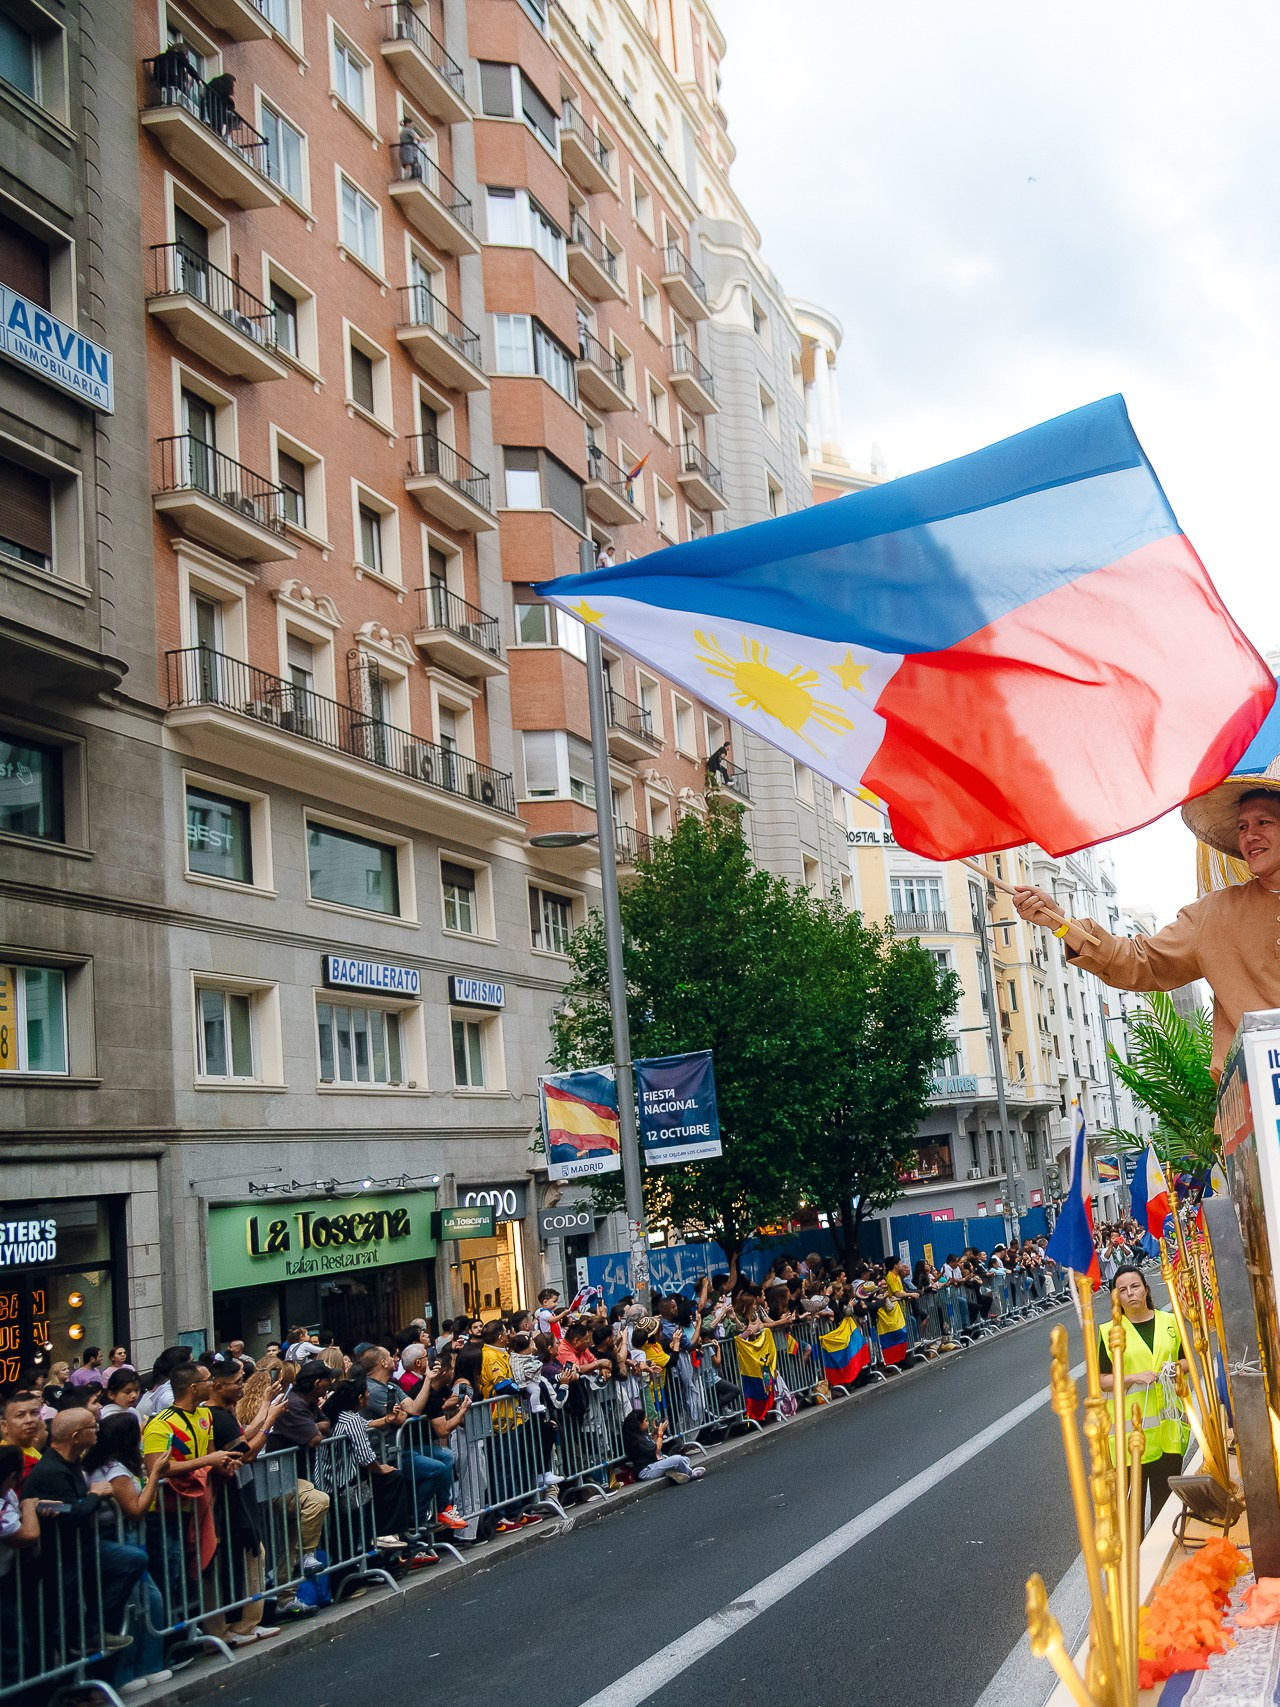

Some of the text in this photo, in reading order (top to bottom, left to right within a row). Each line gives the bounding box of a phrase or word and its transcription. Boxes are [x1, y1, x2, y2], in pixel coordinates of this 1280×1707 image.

[8, 299, 108, 386] ARVIN
[15, 338, 102, 400] INMOBILIARIA
[332, 958, 418, 991] BACHILLERATO
[457, 979, 502, 1004] TURISMO
[947, 1076, 976, 1093] AIRES
[643, 1088, 675, 1102] FIESTA
[644, 1099, 698, 1115] NACIONAL
[646, 1124, 710, 1141] 12 OCTUBRE
[571, 1162, 604, 1174] MADRID
[444, 1219, 455, 1227] La
[456, 1216, 489, 1226] Toscana
[543, 1212, 590, 1231] CODO
[247, 1207, 411, 1256] La Toscana
[285, 1248, 379, 1276] Italian Restaurant
